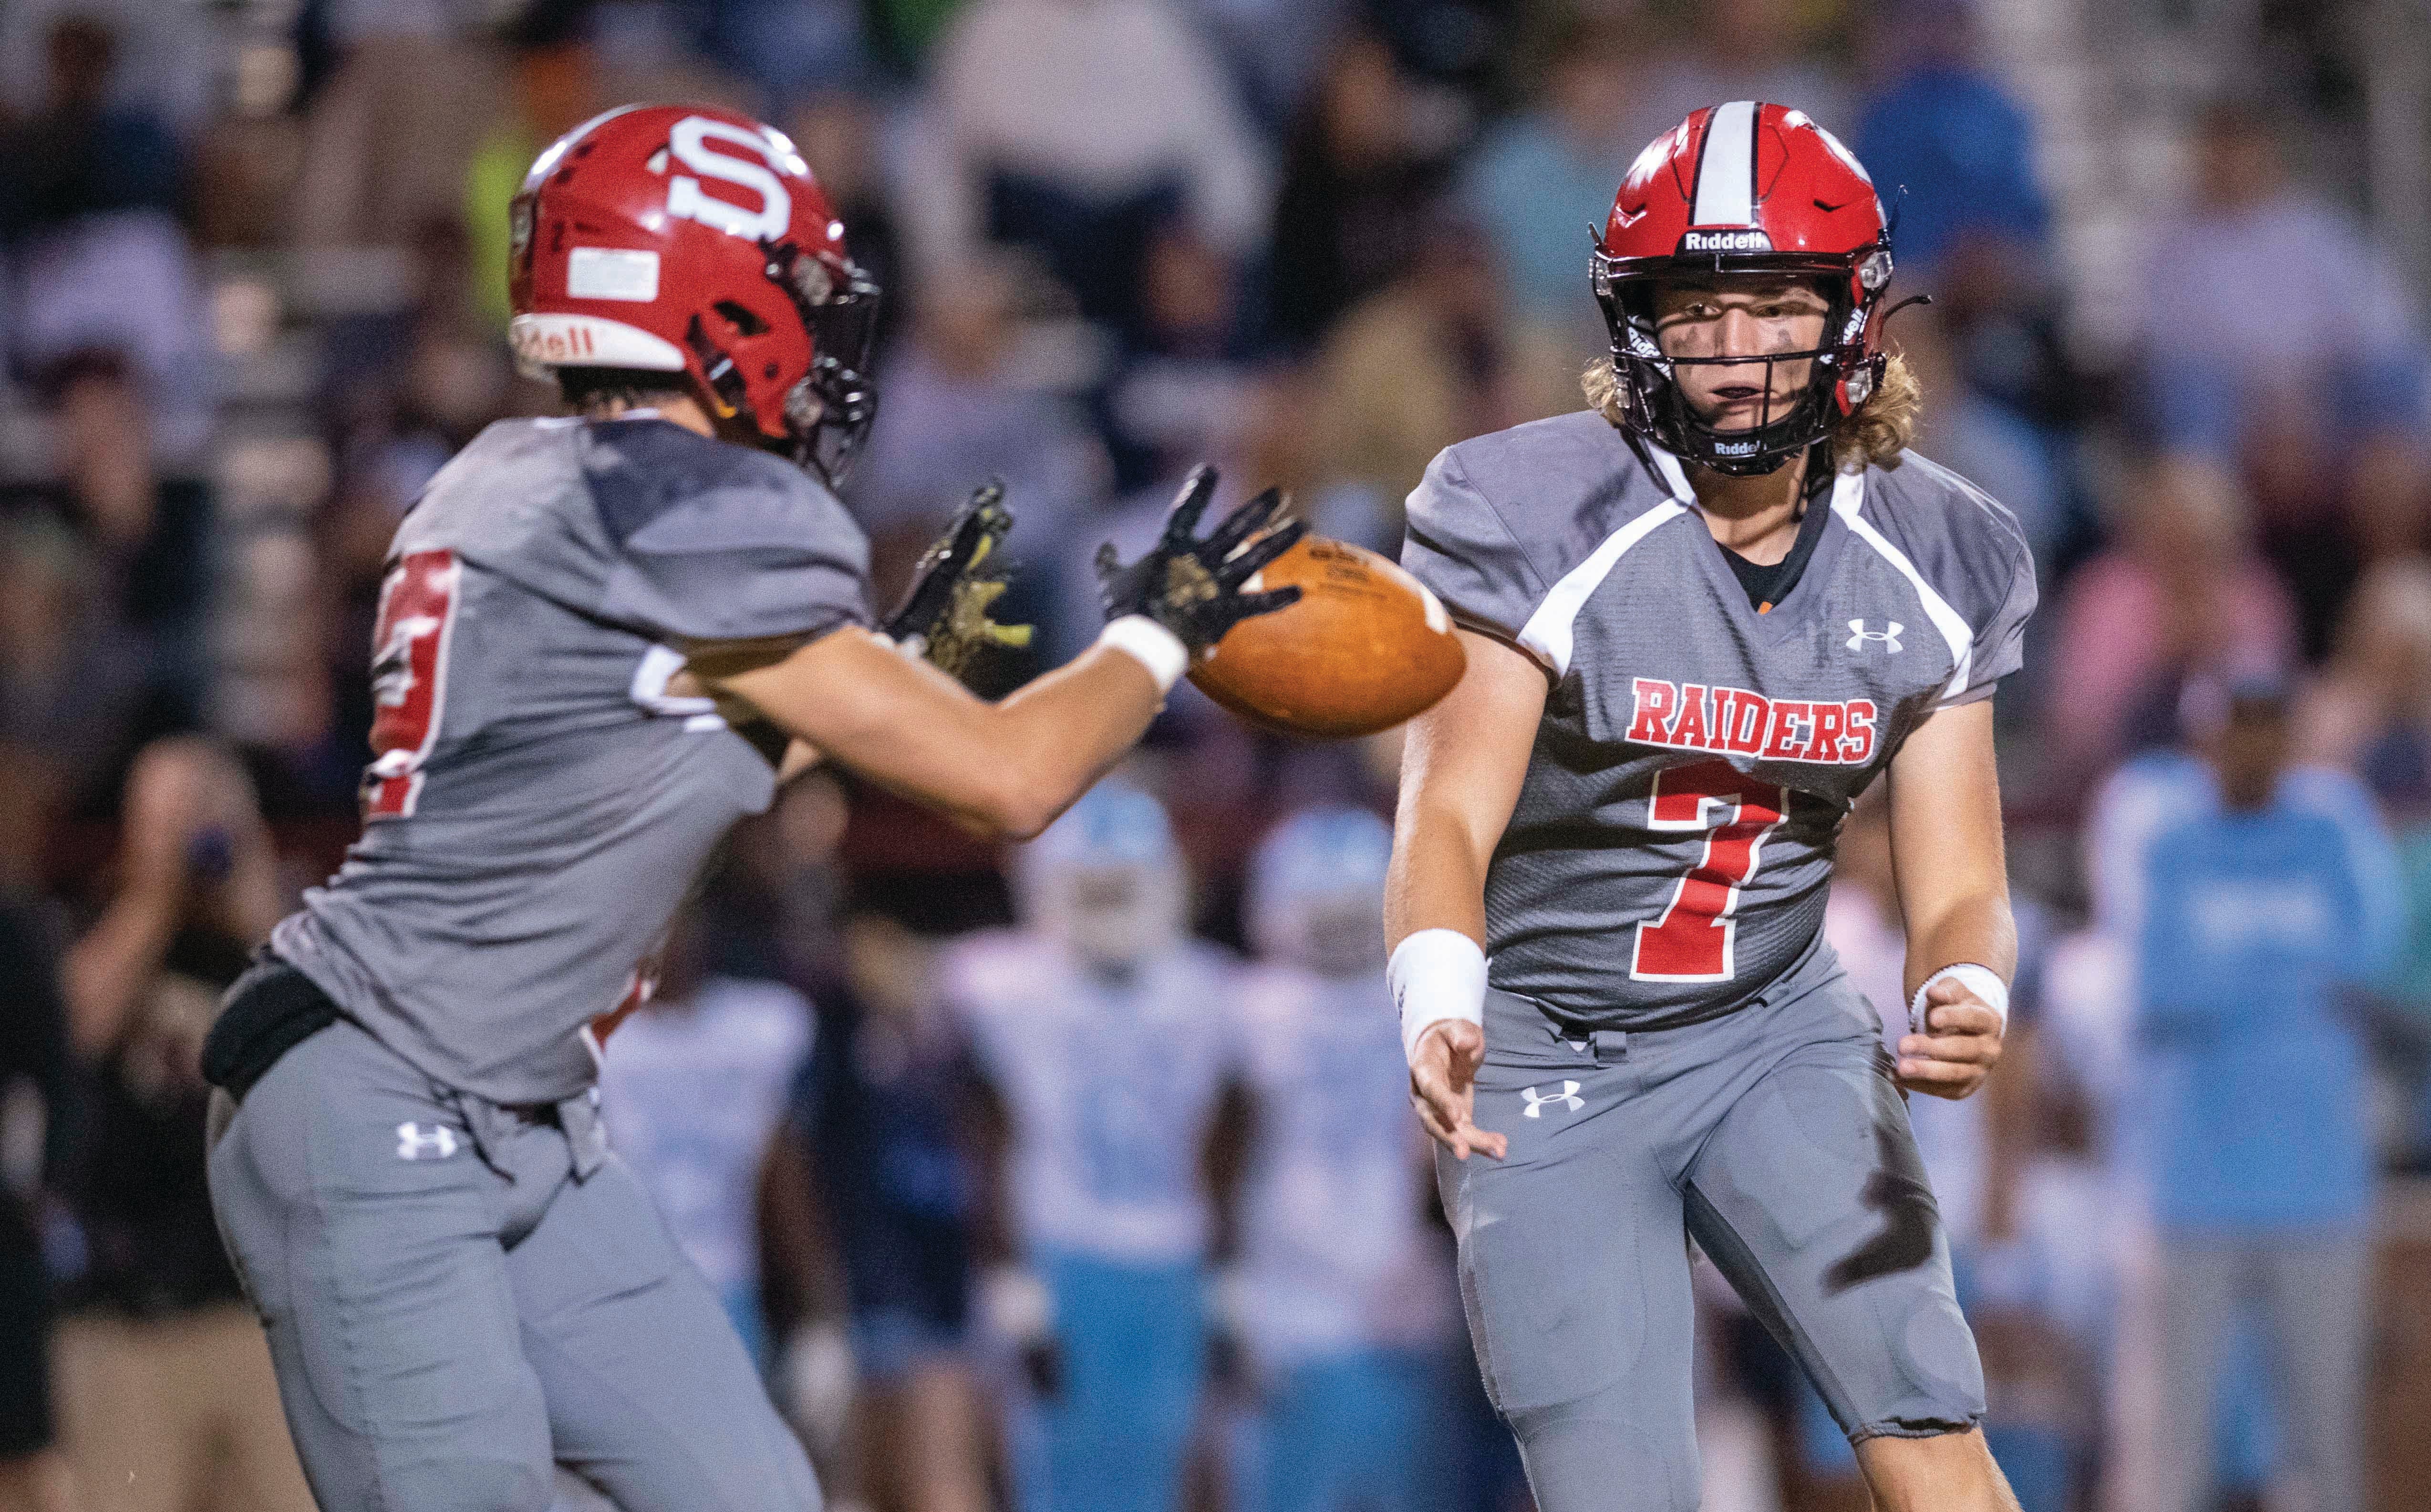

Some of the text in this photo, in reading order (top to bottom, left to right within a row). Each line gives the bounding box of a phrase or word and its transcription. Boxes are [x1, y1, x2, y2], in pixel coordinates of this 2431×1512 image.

[1686, 232, 1762, 250] Riddell
[1625, 677, 1878, 765] RAIDERS
[1629, 758, 1789, 983] 7
